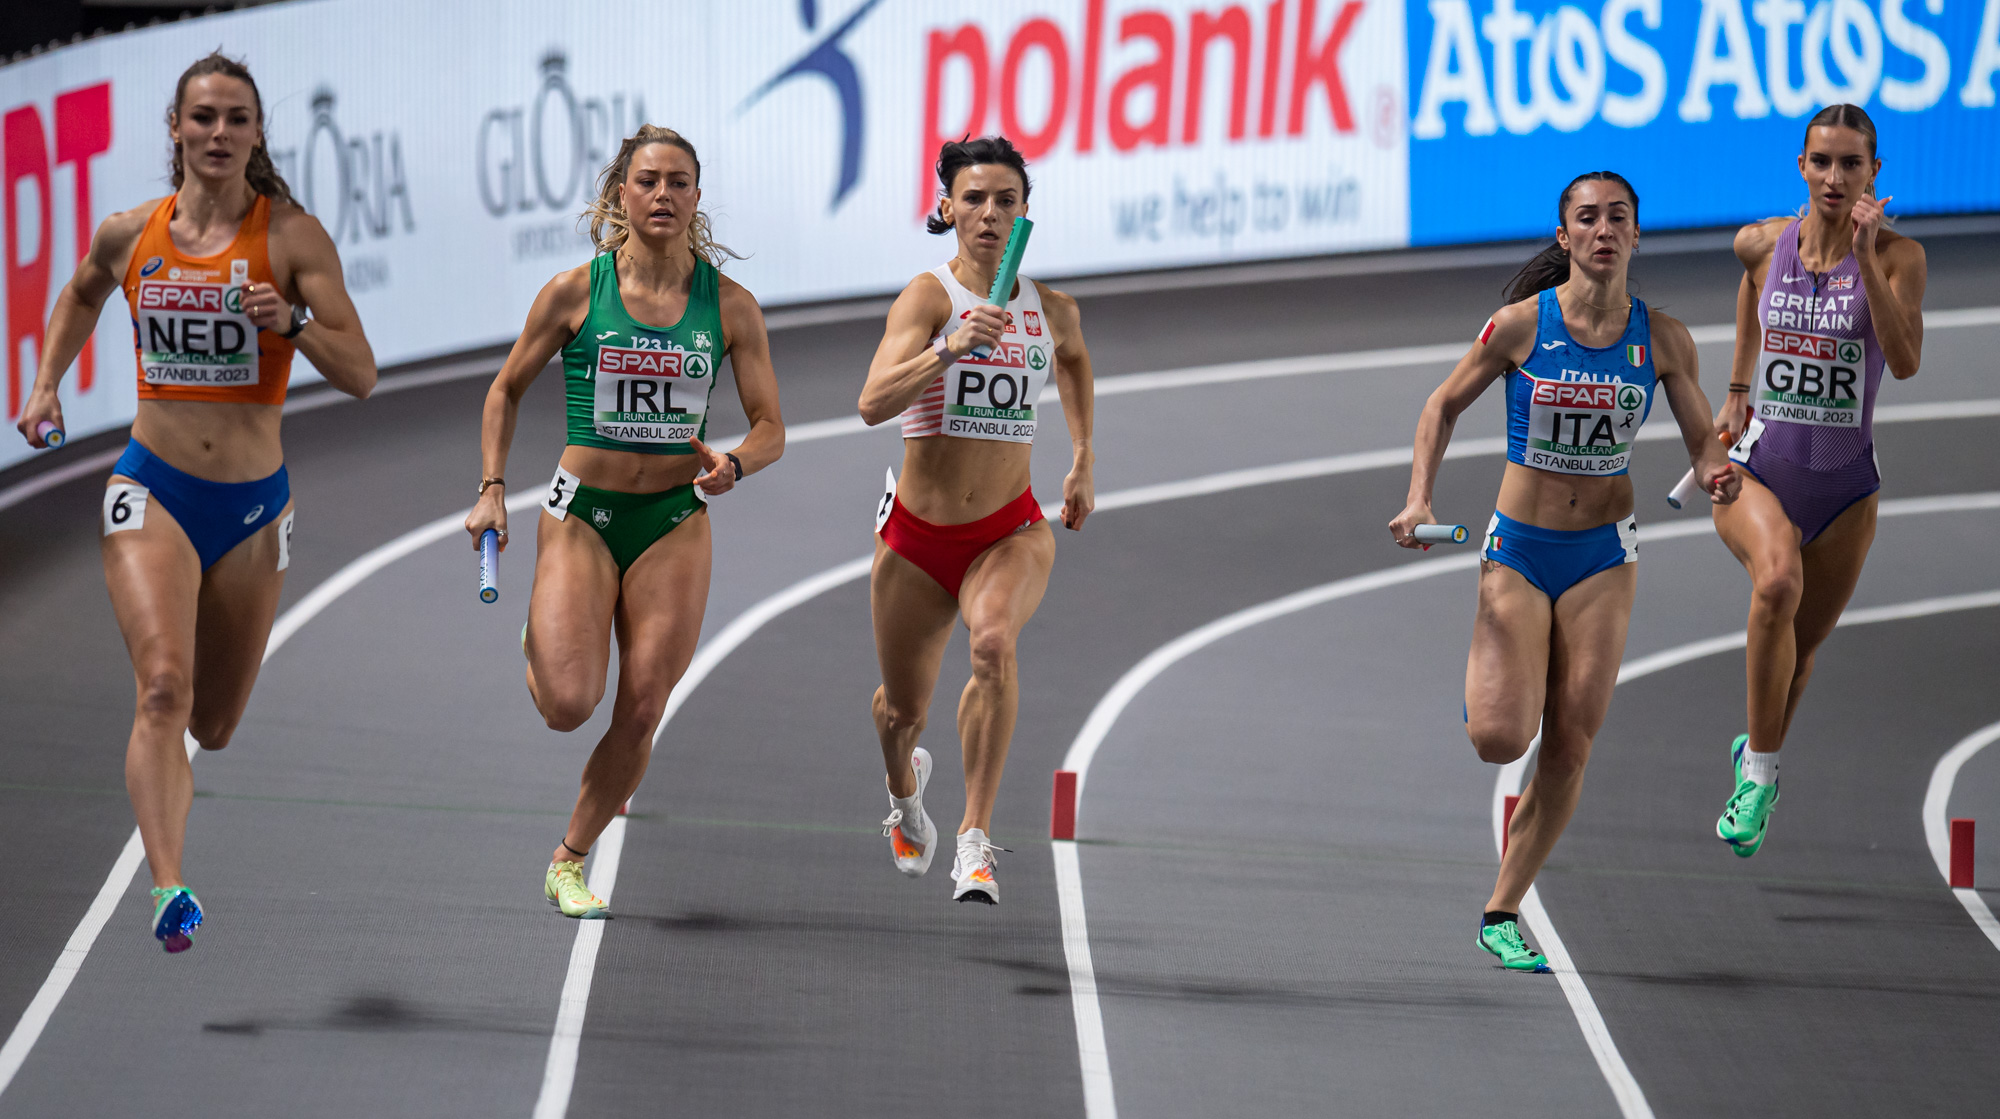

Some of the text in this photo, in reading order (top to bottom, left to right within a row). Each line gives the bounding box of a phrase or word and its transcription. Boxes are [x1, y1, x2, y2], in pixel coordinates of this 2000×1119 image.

[919, 0, 1364, 220] polanik
[476, 73, 645, 217] GLORI
[270, 113, 415, 243] LORIA
[142, 286, 220, 310] SPAR
[1770, 291, 1854, 313] GREAT
[1767, 310, 1853, 331] BRITAIN
[148, 317, 246, 355] NED
[1766, 332, 1835, 358] SPAR
[602, 351, 679, 374] SPAR
[214, 368, 249, 382] 2023
[1765, 359, 1857, 400] GBR
[616, 379, 687, 414] IRL
[956, 370, 1032, 410] POL
[1536, 384, 1613, 406] SPAR
[623, 413, 646, 422] RUN
[647, 414, 681, 423] CLEAN
[973, 408, 994, 418] RUN
[995, 409, 1024, 419] CLEAN
[1761, 404, 1854, 423] ISTANBUL 2023
[667, 427, 695, 439] 2023
[949, 419, 1034, 437] ISTANBUL 2023
[1551, 412, 1617, 447] ITA
[1555, 444, 1577, 454] RUN
[1579, 446, 1613, 455] CLEAN
[1532, 452, 1625, 471] ISTANBUL 2023
[548, 475, 567, 508] 5
[111, 490, 132, 525] 6
